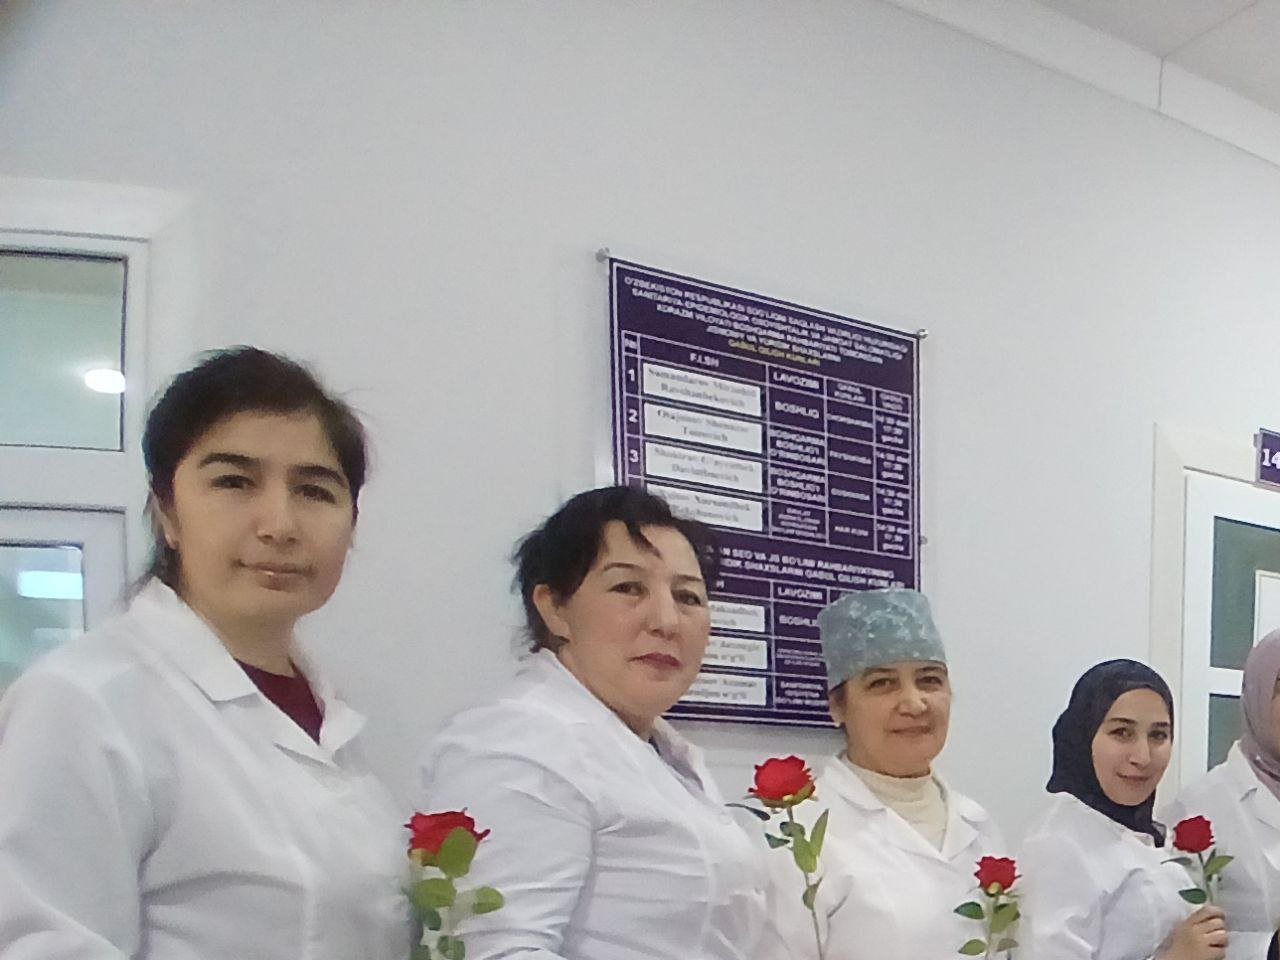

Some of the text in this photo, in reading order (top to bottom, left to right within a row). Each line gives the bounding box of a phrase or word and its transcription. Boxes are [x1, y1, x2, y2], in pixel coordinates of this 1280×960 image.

[628, 368, 636, 382] 1
[628, 409, 638, 423] 2
[774, 401, 820, 419] BOSHLIQ
[629, 449, 640, 463] 3
[779, 614, 818, 627] BOSHLI
